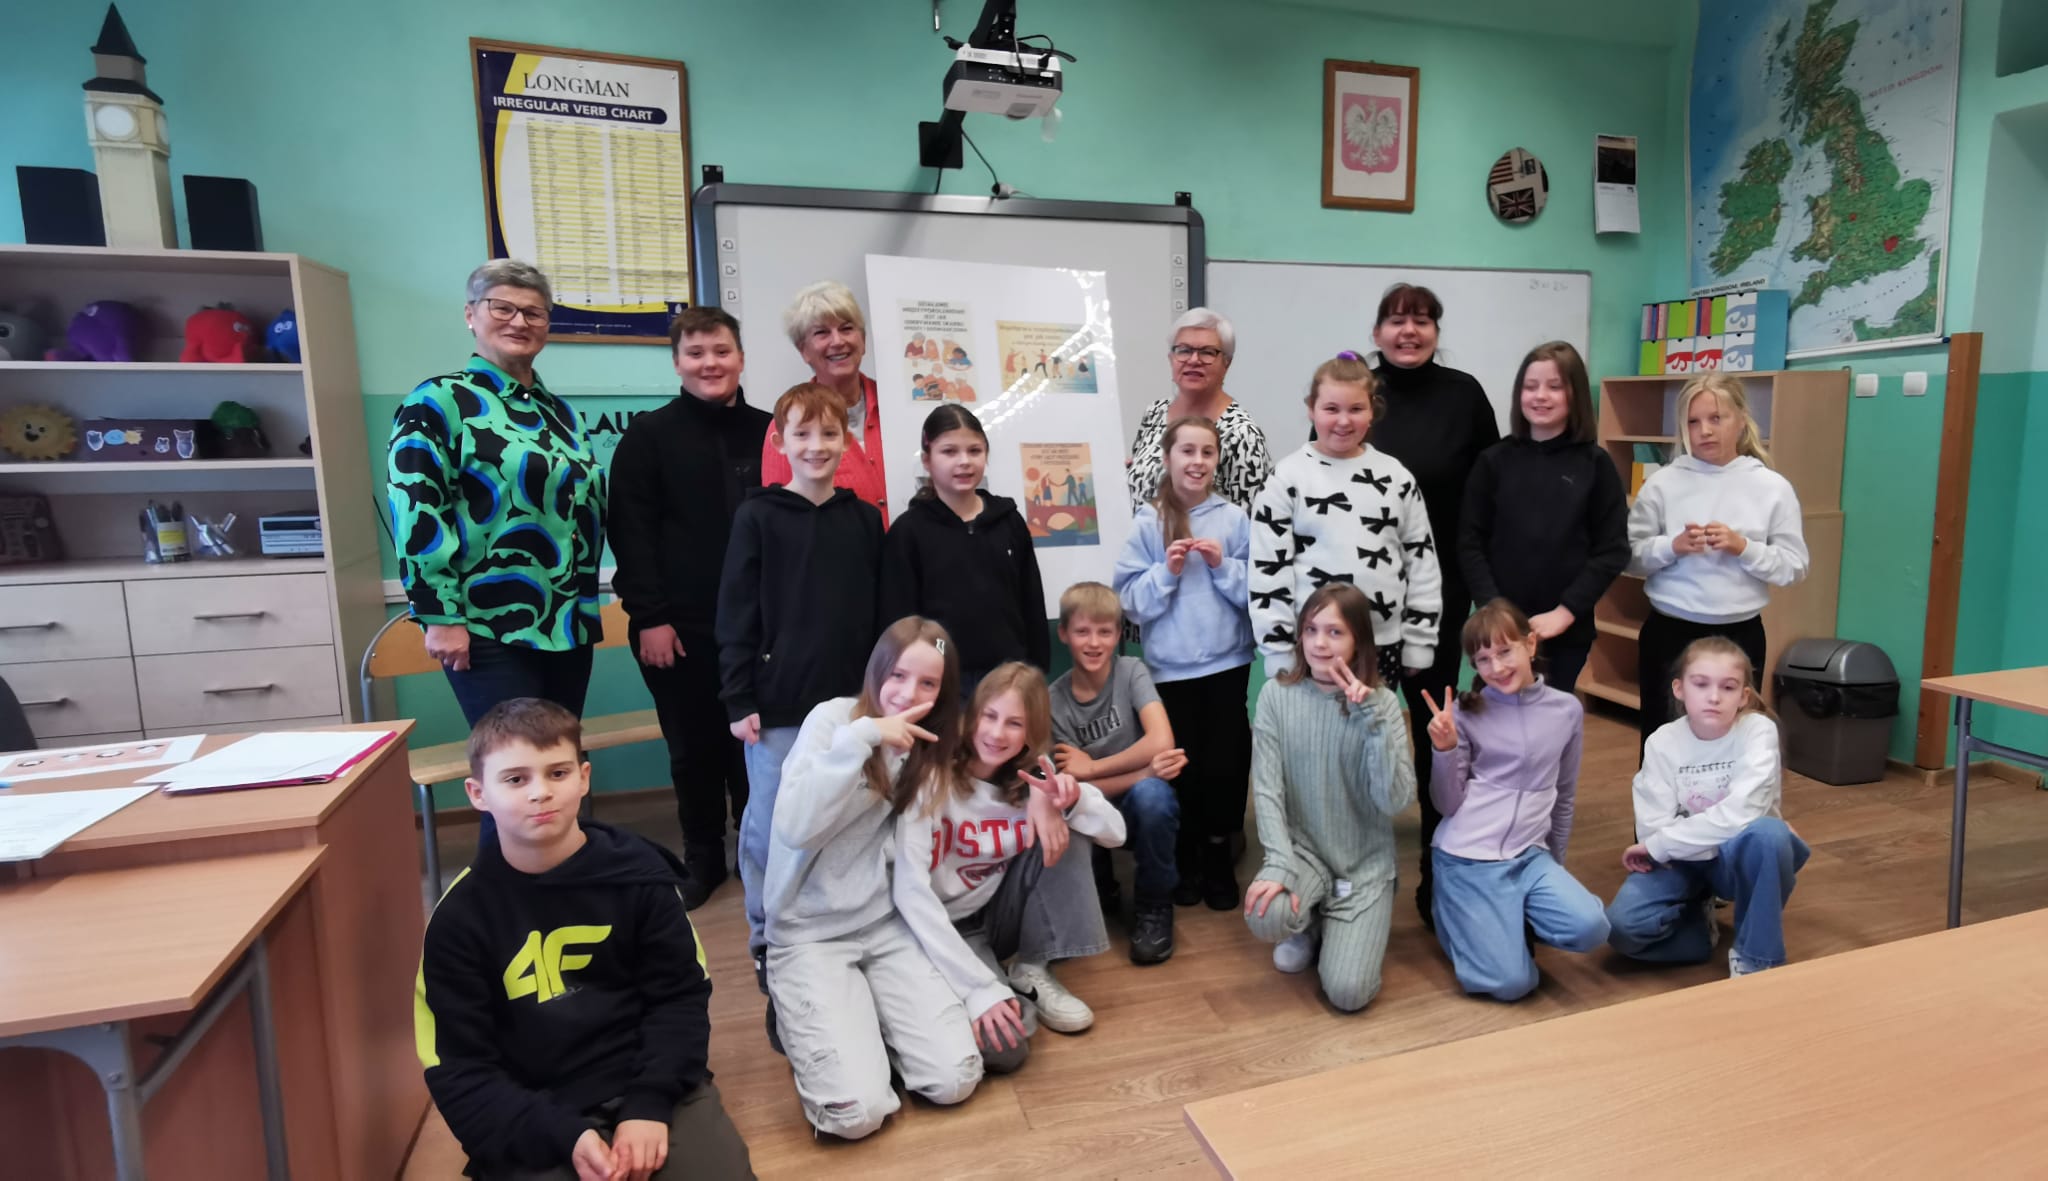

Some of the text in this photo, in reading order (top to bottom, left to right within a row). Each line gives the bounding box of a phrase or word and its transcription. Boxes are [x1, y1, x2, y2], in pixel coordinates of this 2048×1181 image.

[523, 72, 630, 98] LONGMAN
[1896, 63, 1944, 88] KINGDOM
[493, 95, 653, 121] IRREGULAR VERB CHART
[1740, 278, 1766, 287] IRELAND
[503, 924, 612, 1003] 4F
